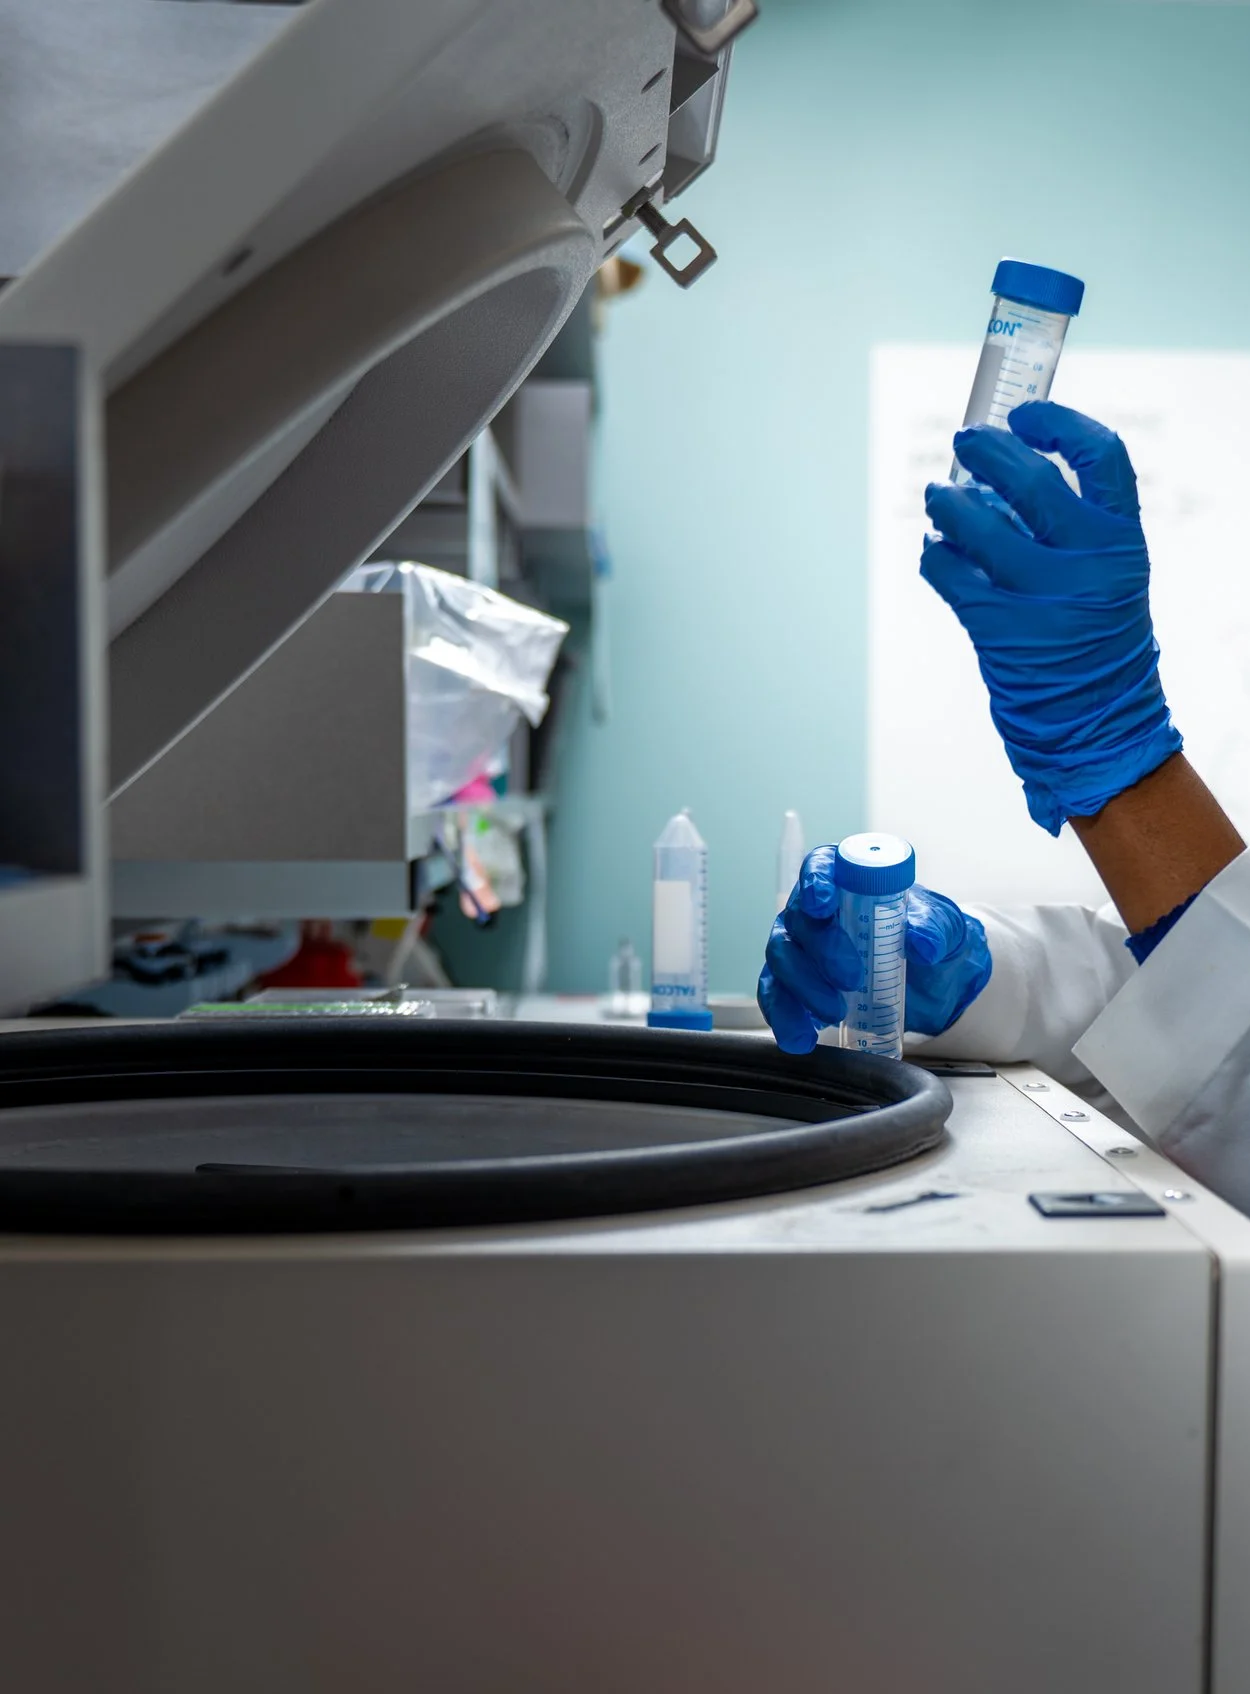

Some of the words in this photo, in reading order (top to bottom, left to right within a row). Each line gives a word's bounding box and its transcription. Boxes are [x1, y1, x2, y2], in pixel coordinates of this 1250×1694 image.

[858, 914, 870, 923] 45
[857, 1003, 868, 1012] 20
[857, 1039, 868, 1048] 10
